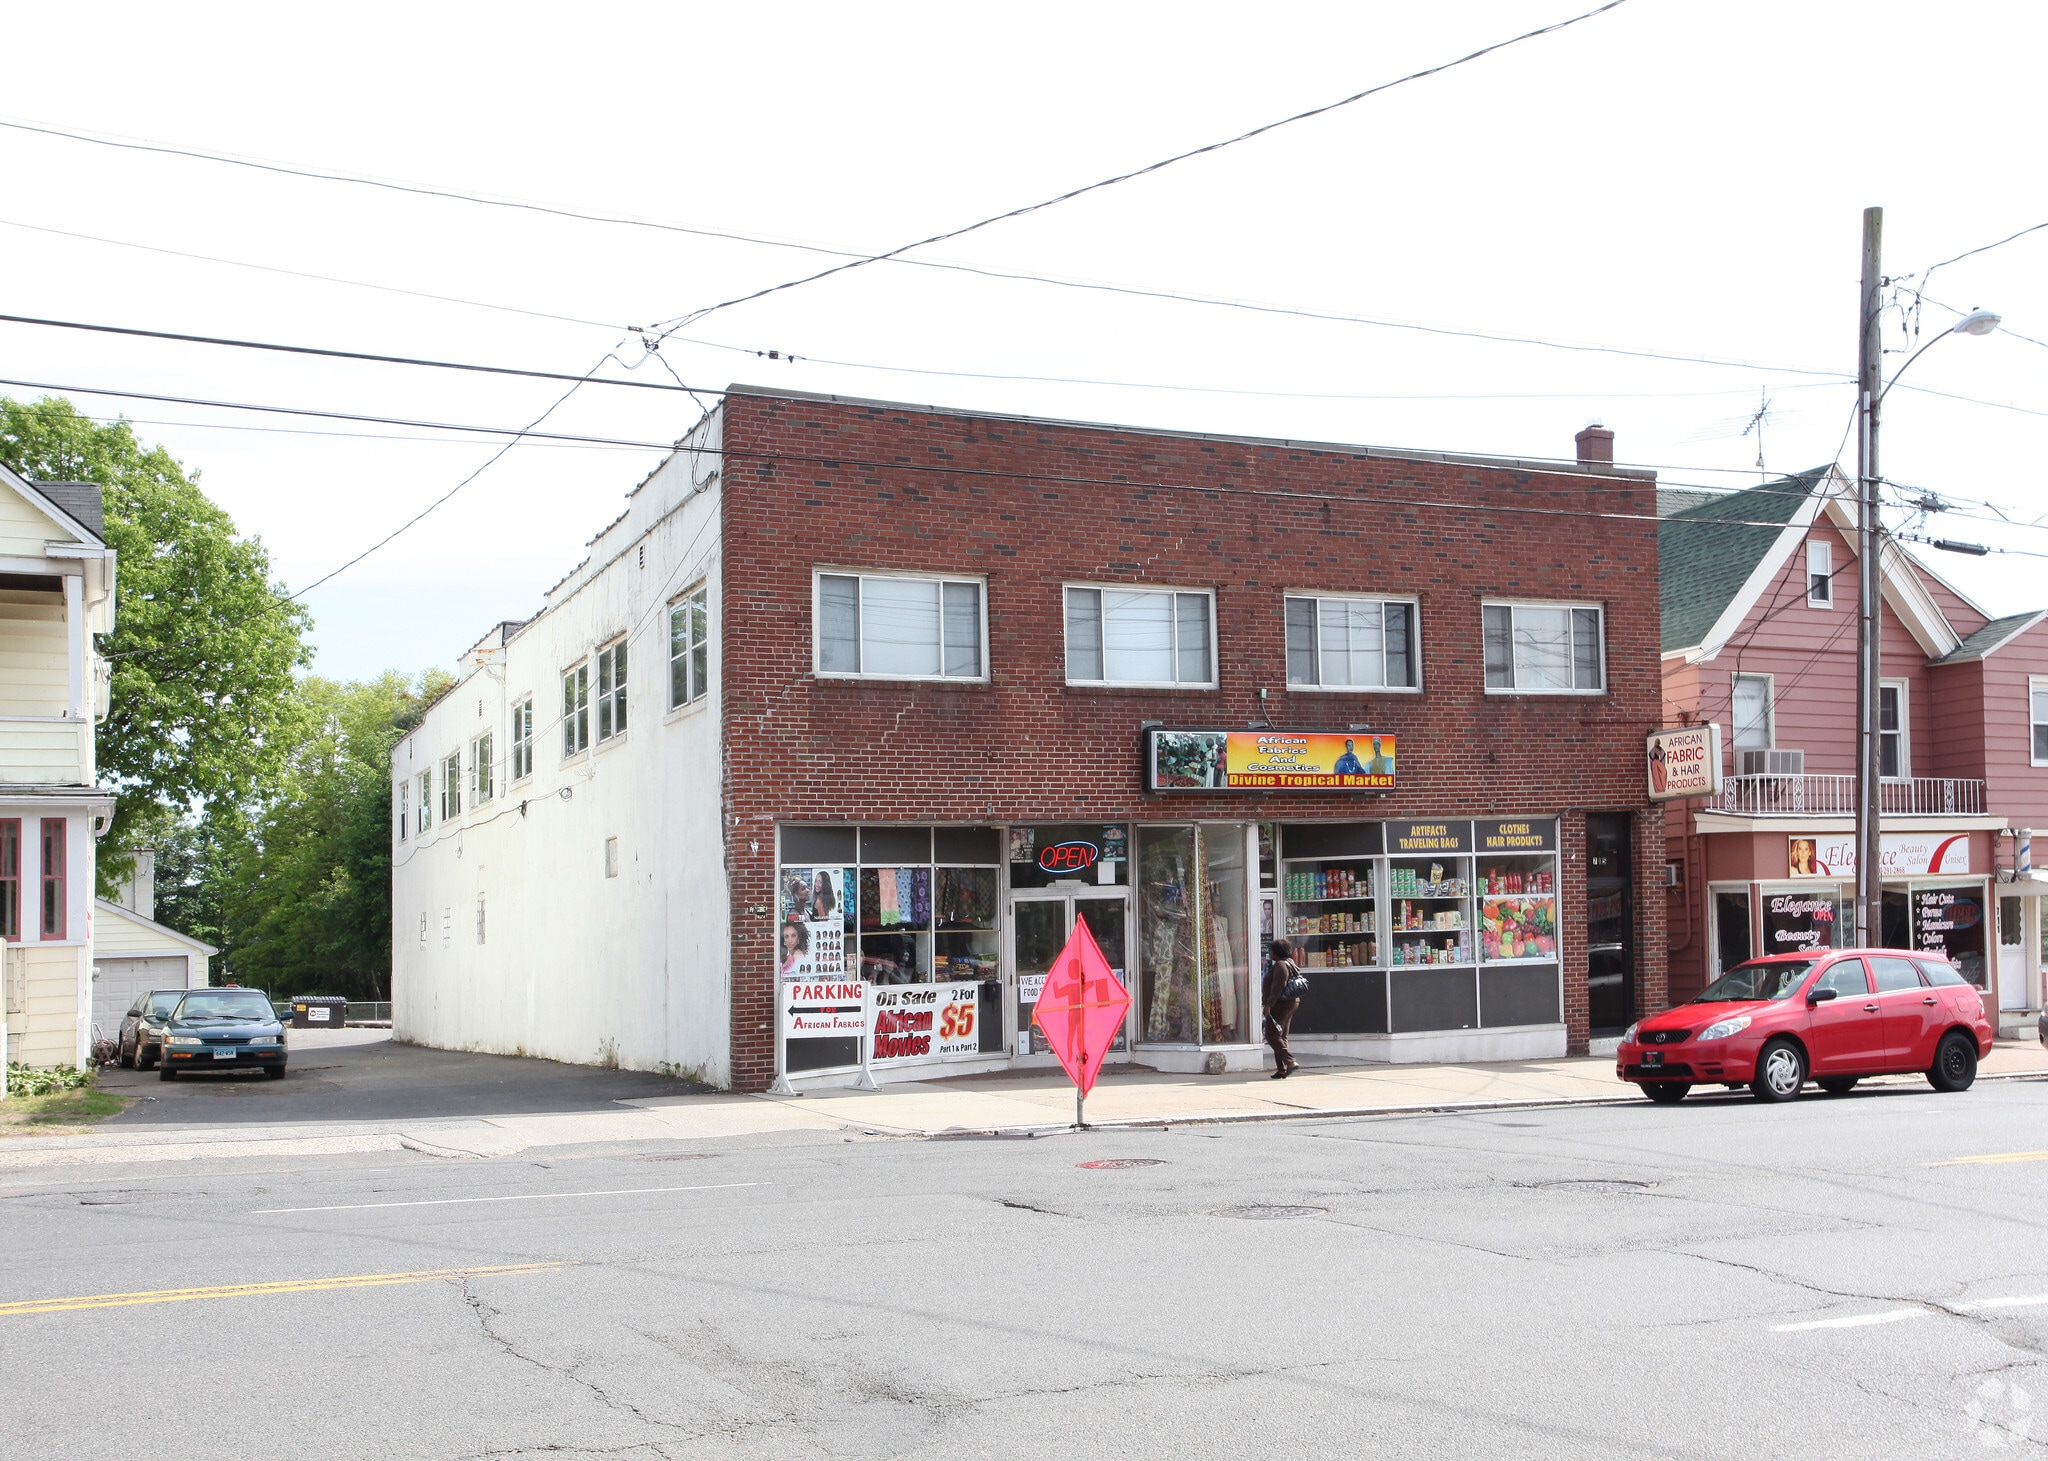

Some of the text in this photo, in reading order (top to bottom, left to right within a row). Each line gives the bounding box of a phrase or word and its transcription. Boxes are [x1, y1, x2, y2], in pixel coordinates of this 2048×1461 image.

[1257, 736, 1307, 745] African
[1669, 734, 1703, 747] AFRICAN
[1258, 746, 1307, 755] Fabrics
[1667, 746, 1704, 764] FABRIC
[1269, 756, 1296, 764] And
[1247, 763, 1321, 773] Cosmetics
[1672, 764, 1700, 777] & HAIR
[1229, 773, 1394, 787] Divine Tropical Market
[1667, 777, 1706, 790] PRODUCTS
[1410, 825, 1447, 837] ARTIFACTS
[1499, 824, 1530, 834] CLOTHES
[1399, 837, 1459, 849] TRAVELING BAGS
[1486, 835, 1543, 847] HAIR PRODUCTS
[1900, 844, 1928, 855] Beauty
[1040, 846, 1094, 867] OPEN
[1825, 843, 1897, 874] Elece
[1906, 855, 1928, 866] Salon
[1944, 853, 1967, 865] Unisex
[1771, 895, 1832, 917] Elegance
[1813, 911, 1834, 921] OPEN
[1775, 929, 1820, 944] Beauty
[1021, 977, 1033, 986] WE
[793, 984, 862, 1000] PARKING
[875, 990, 937, 1006] On Sale
[951, 989, 975, 1001] 2 For
[1024, 988, 1038, 996] FOOD
[793, 1016, 865, 1030] AFRICAN FABRICS
[874, 1009, 933, 1034] African
[939, 1002, 976, 1042] $5
[873, 1033, 931, 1059] Movies
[940, 1045, 952, 1053] Part
[960, 1043, 972, 1052] Part
[973, 1042, 977, 1051] 2
